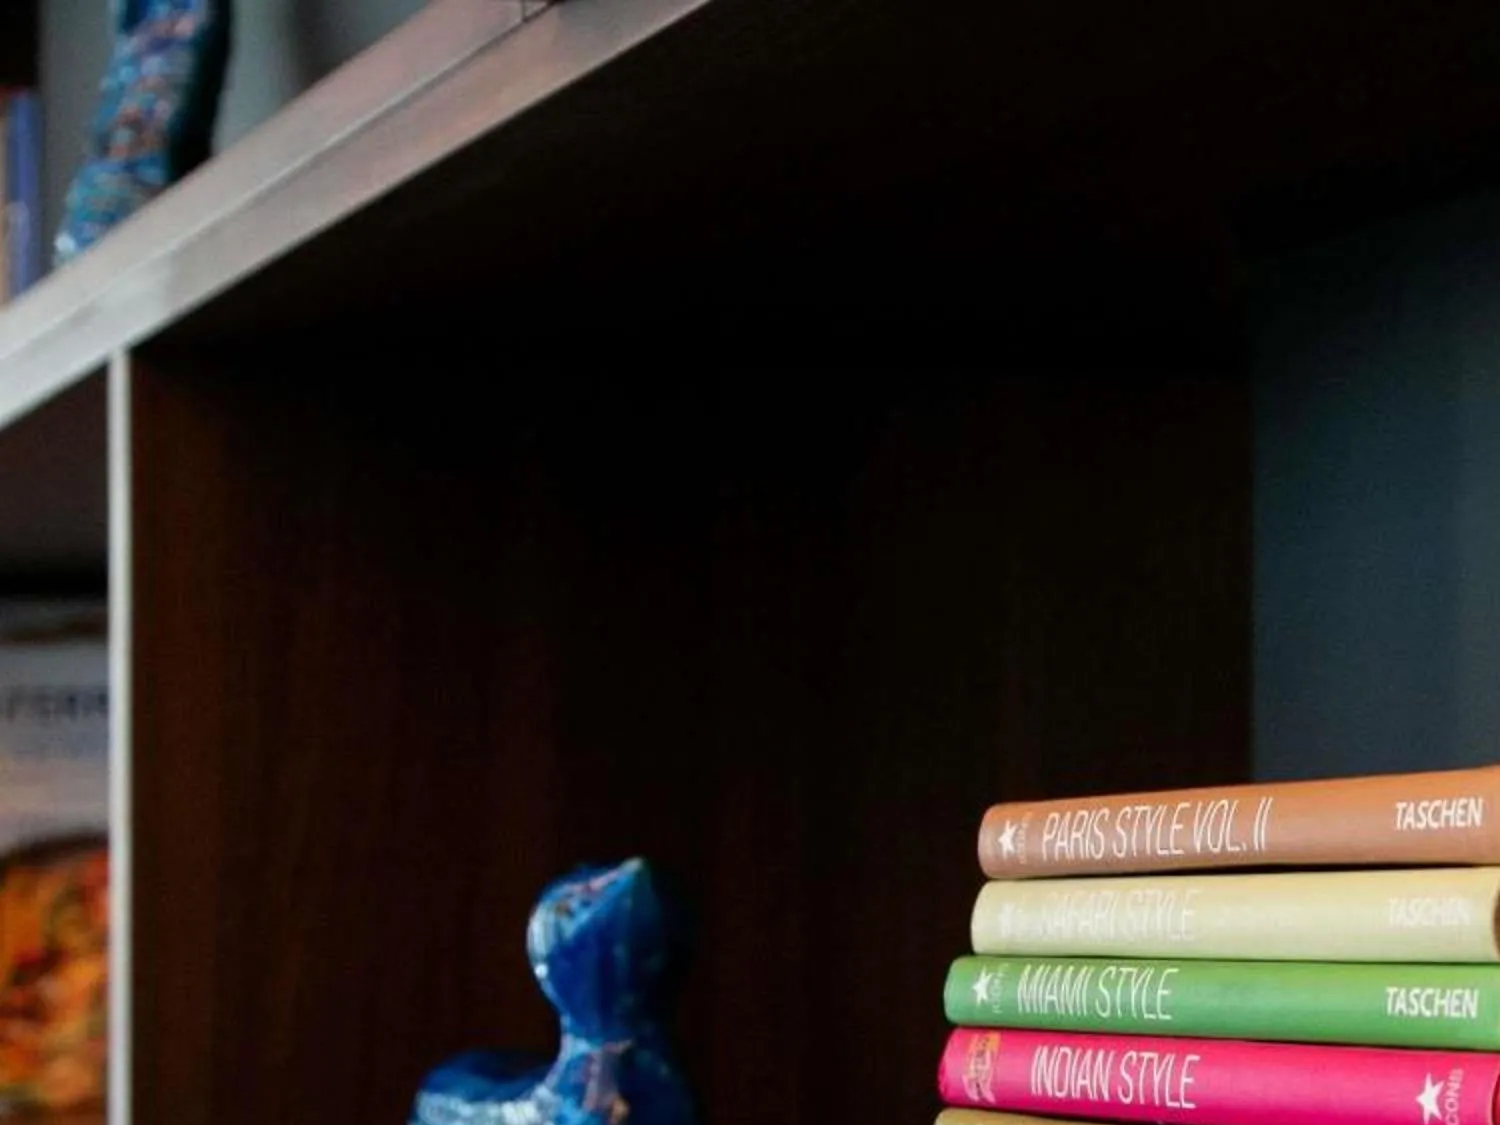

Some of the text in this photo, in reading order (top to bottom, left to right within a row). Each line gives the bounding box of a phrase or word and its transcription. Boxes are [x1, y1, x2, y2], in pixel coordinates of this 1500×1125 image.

[1042, 796, 1274, 861] PARIS STYLE VOL. II
[1394, 796, 1484, 831] TASCHEN
[1123, 889, 1202, 941] STYLE
[1388, 896, 1472, 926] TASCHEN
[1016, 964, 1179, 1020] MIAMI STYLE
[1386, 986, 1479, 1019] TASCHEN
[1031, 1045, 1200, 1109] INDIAN STYLE
